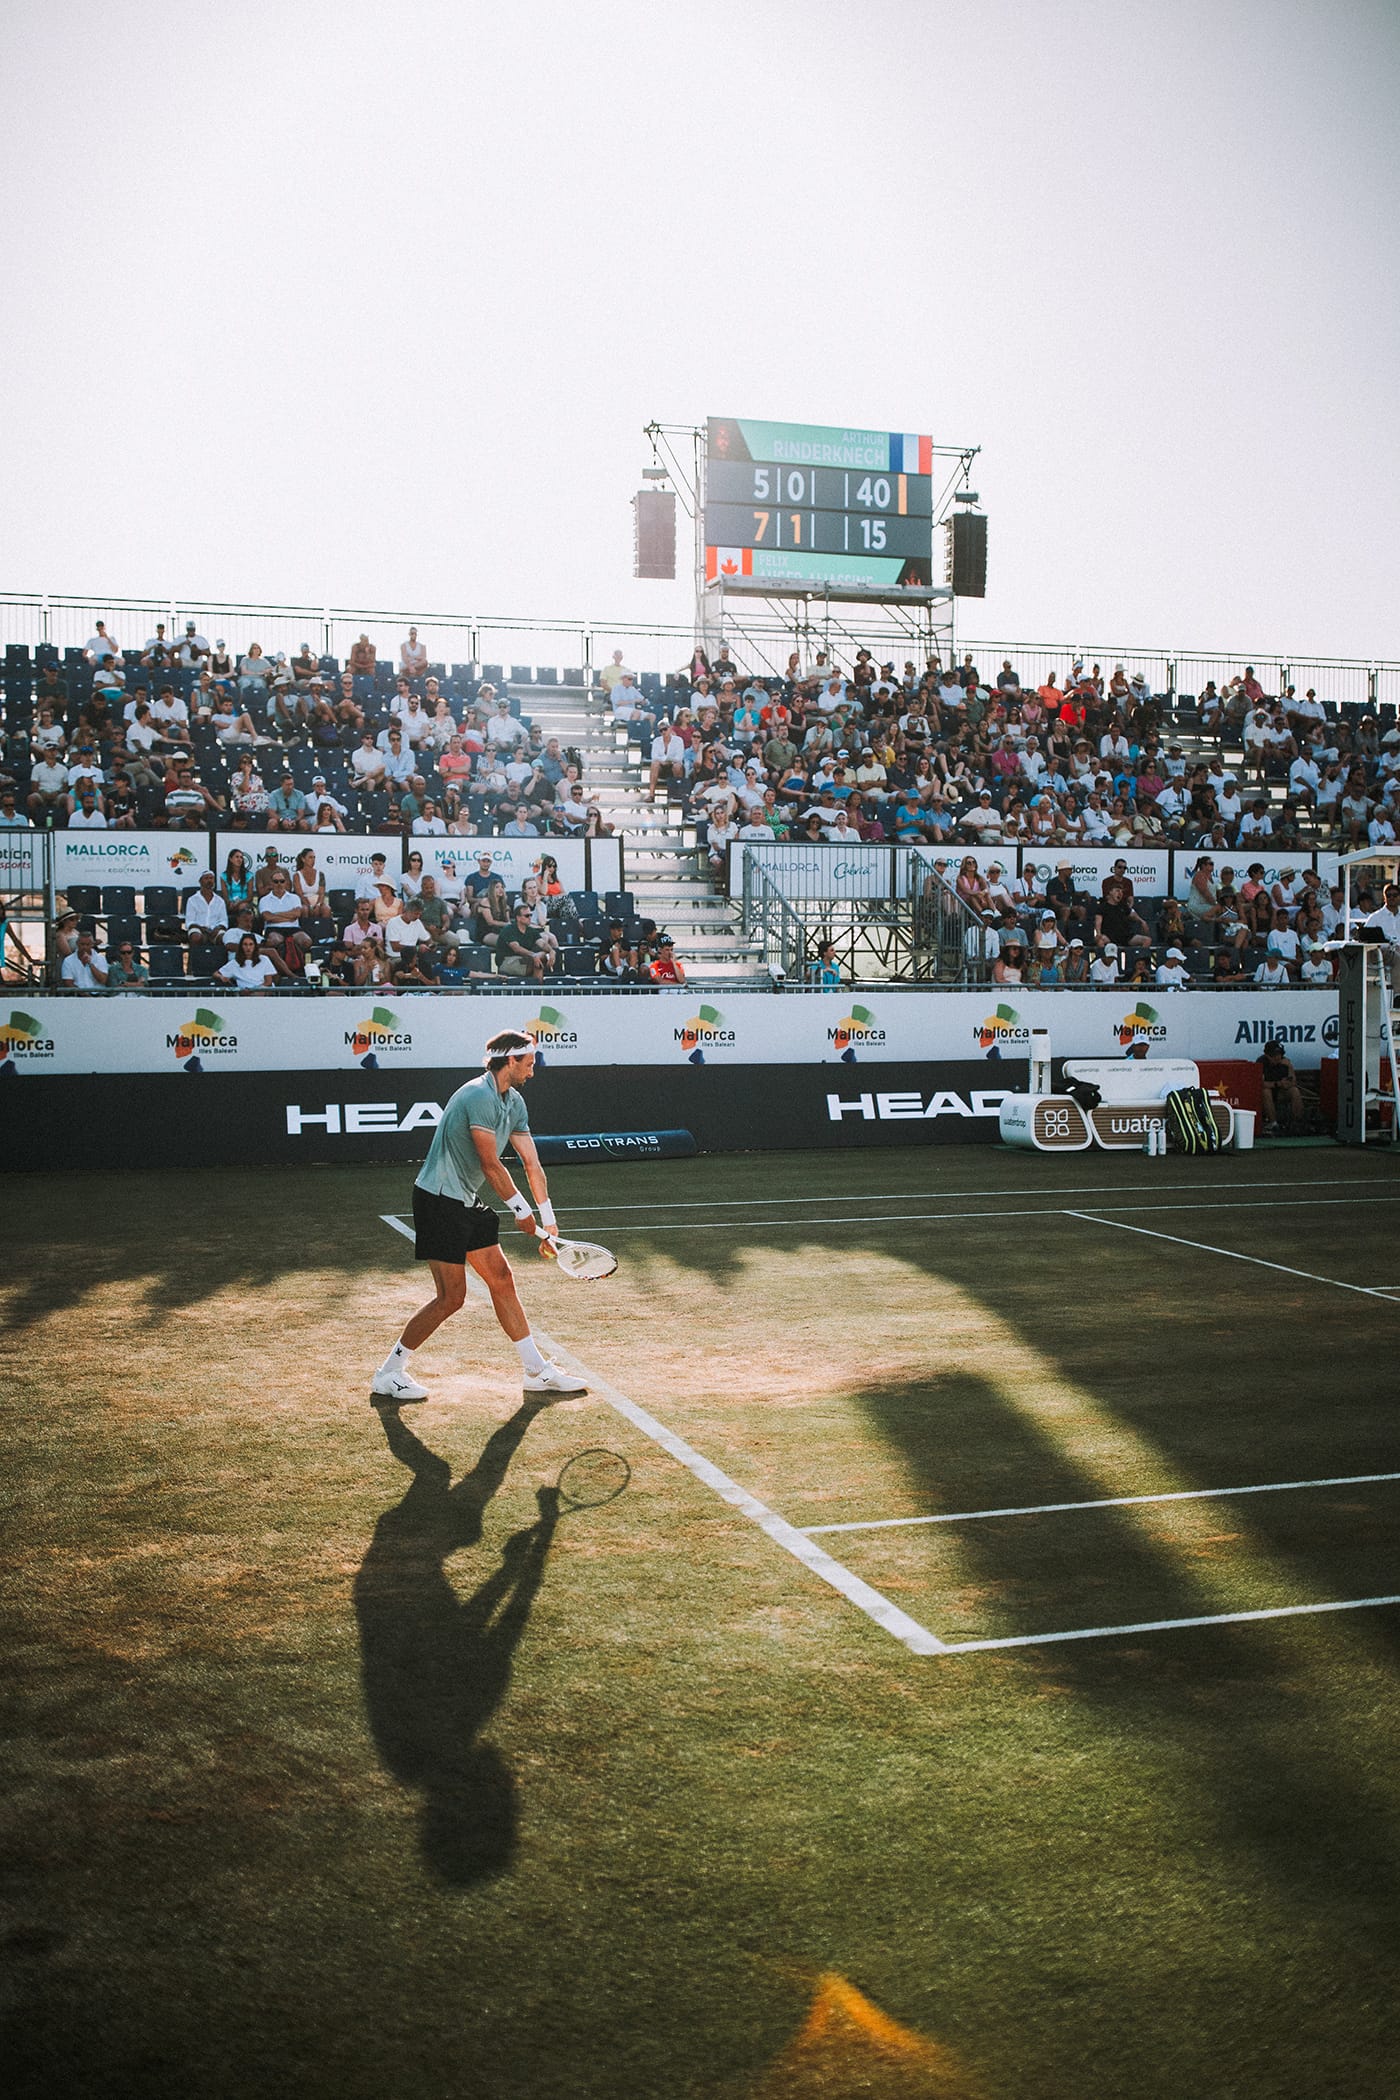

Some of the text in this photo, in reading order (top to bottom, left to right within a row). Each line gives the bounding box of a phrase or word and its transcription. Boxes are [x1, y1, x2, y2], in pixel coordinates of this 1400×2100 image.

[842, 431, 885, 446] ARTHUR
[773, 440, 885, 466] RINDERKNECH
[753, 469, 891, 509] 5 0 40
[753, 511, 887, 550] 7 1 15
[759, 554, 789, 567] FELIX
[66, 844, 150, 856] MALLORCA
[434, 850, 513, 861] MALLOCA
[762, 863, 820, 872] MALLORCA
[344, 1031, 412, 1046] Mallorca
[674, 1028, 735, 1041] Mallorca
[827, 1028, 886, 1041] Mallorca
[973, 1026, 1029, 1039] Mallorca
[1113, 1020, 1316, 1044] Mallorca Allianz
[166, 1033, 238, 1049] Mallorca
[826, 1089, 1012, 1121] HEAD
[286, 1102, 443, 1135] HEA
[1111, 1114, 1168, 1134] water
[566, 1135, 659, 1149] ECO TRANS
[640, 1145, 661, 1153] Group
